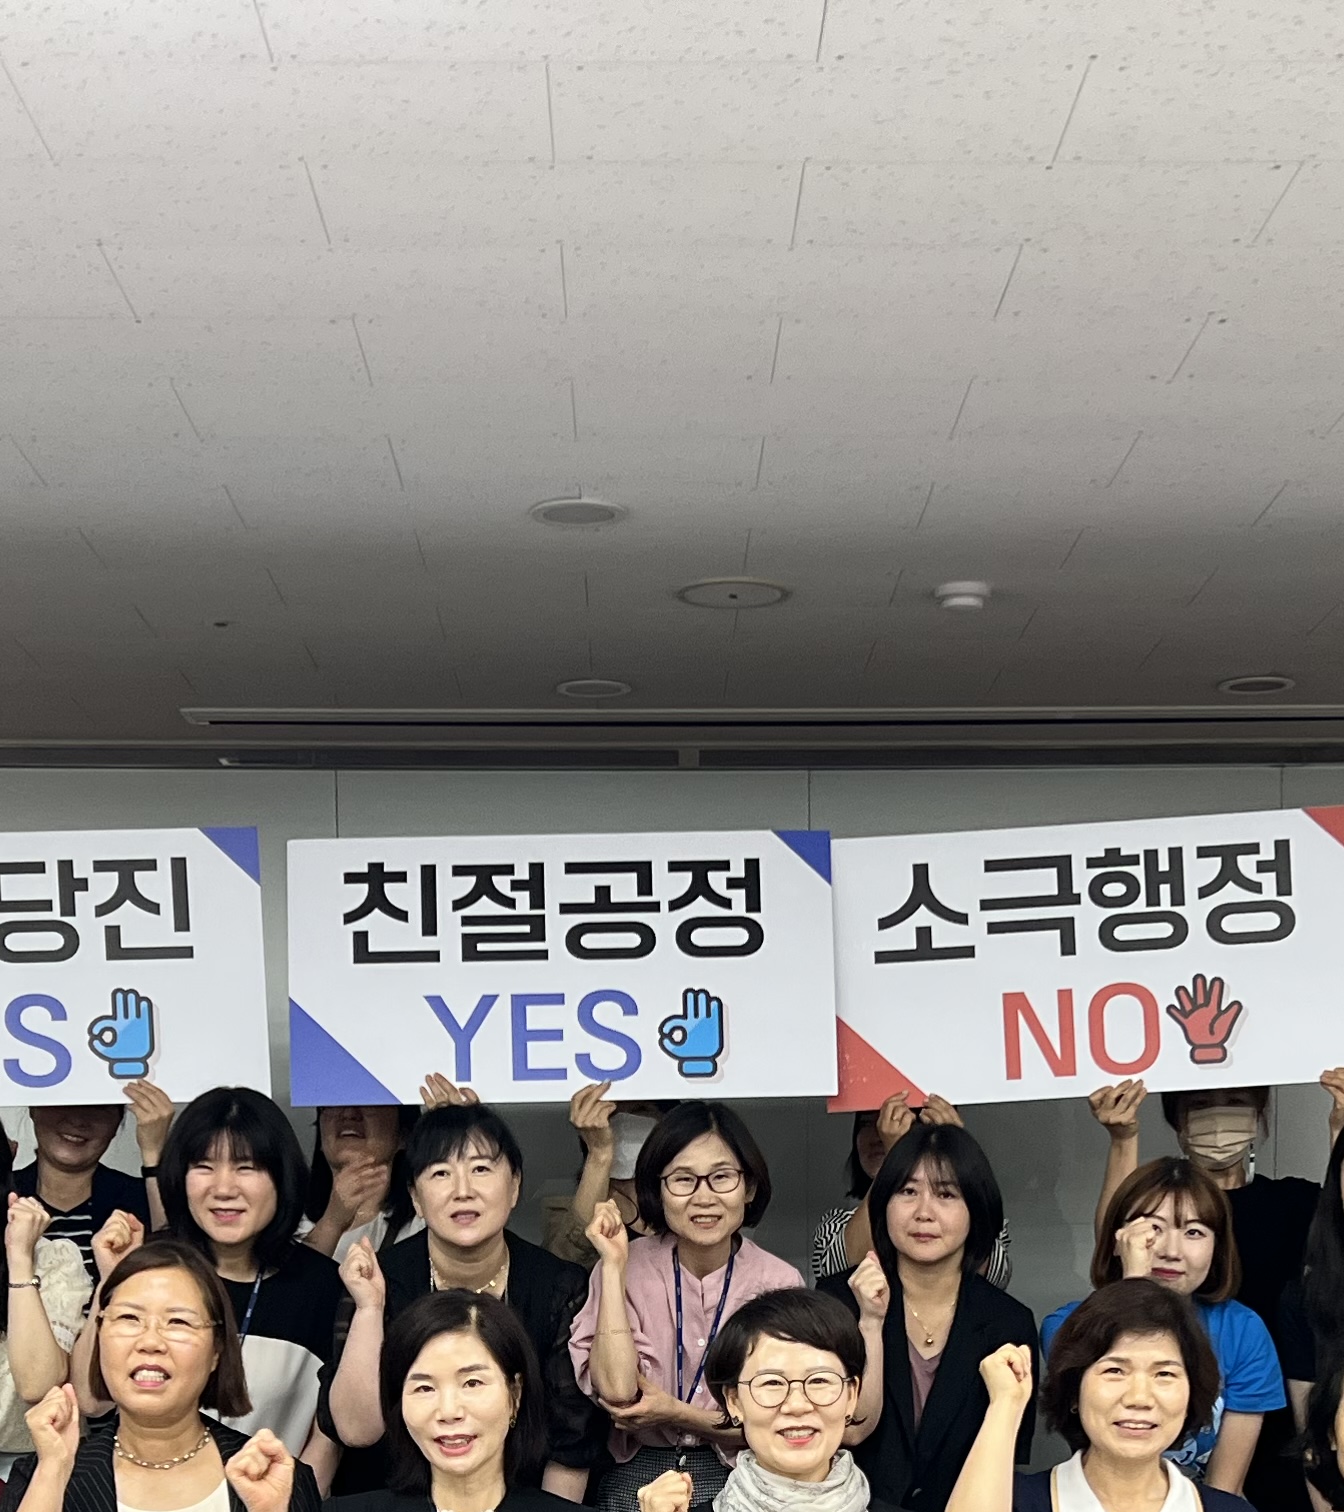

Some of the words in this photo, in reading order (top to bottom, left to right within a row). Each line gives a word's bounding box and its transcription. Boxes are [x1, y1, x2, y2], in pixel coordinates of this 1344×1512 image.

[343, 858, 764, 964] 친절공정
[874, 838, 1296, 964] 소극행정
[423, 989, 642, 1081] YES
[1002, 982, 1161, 1080] NO
